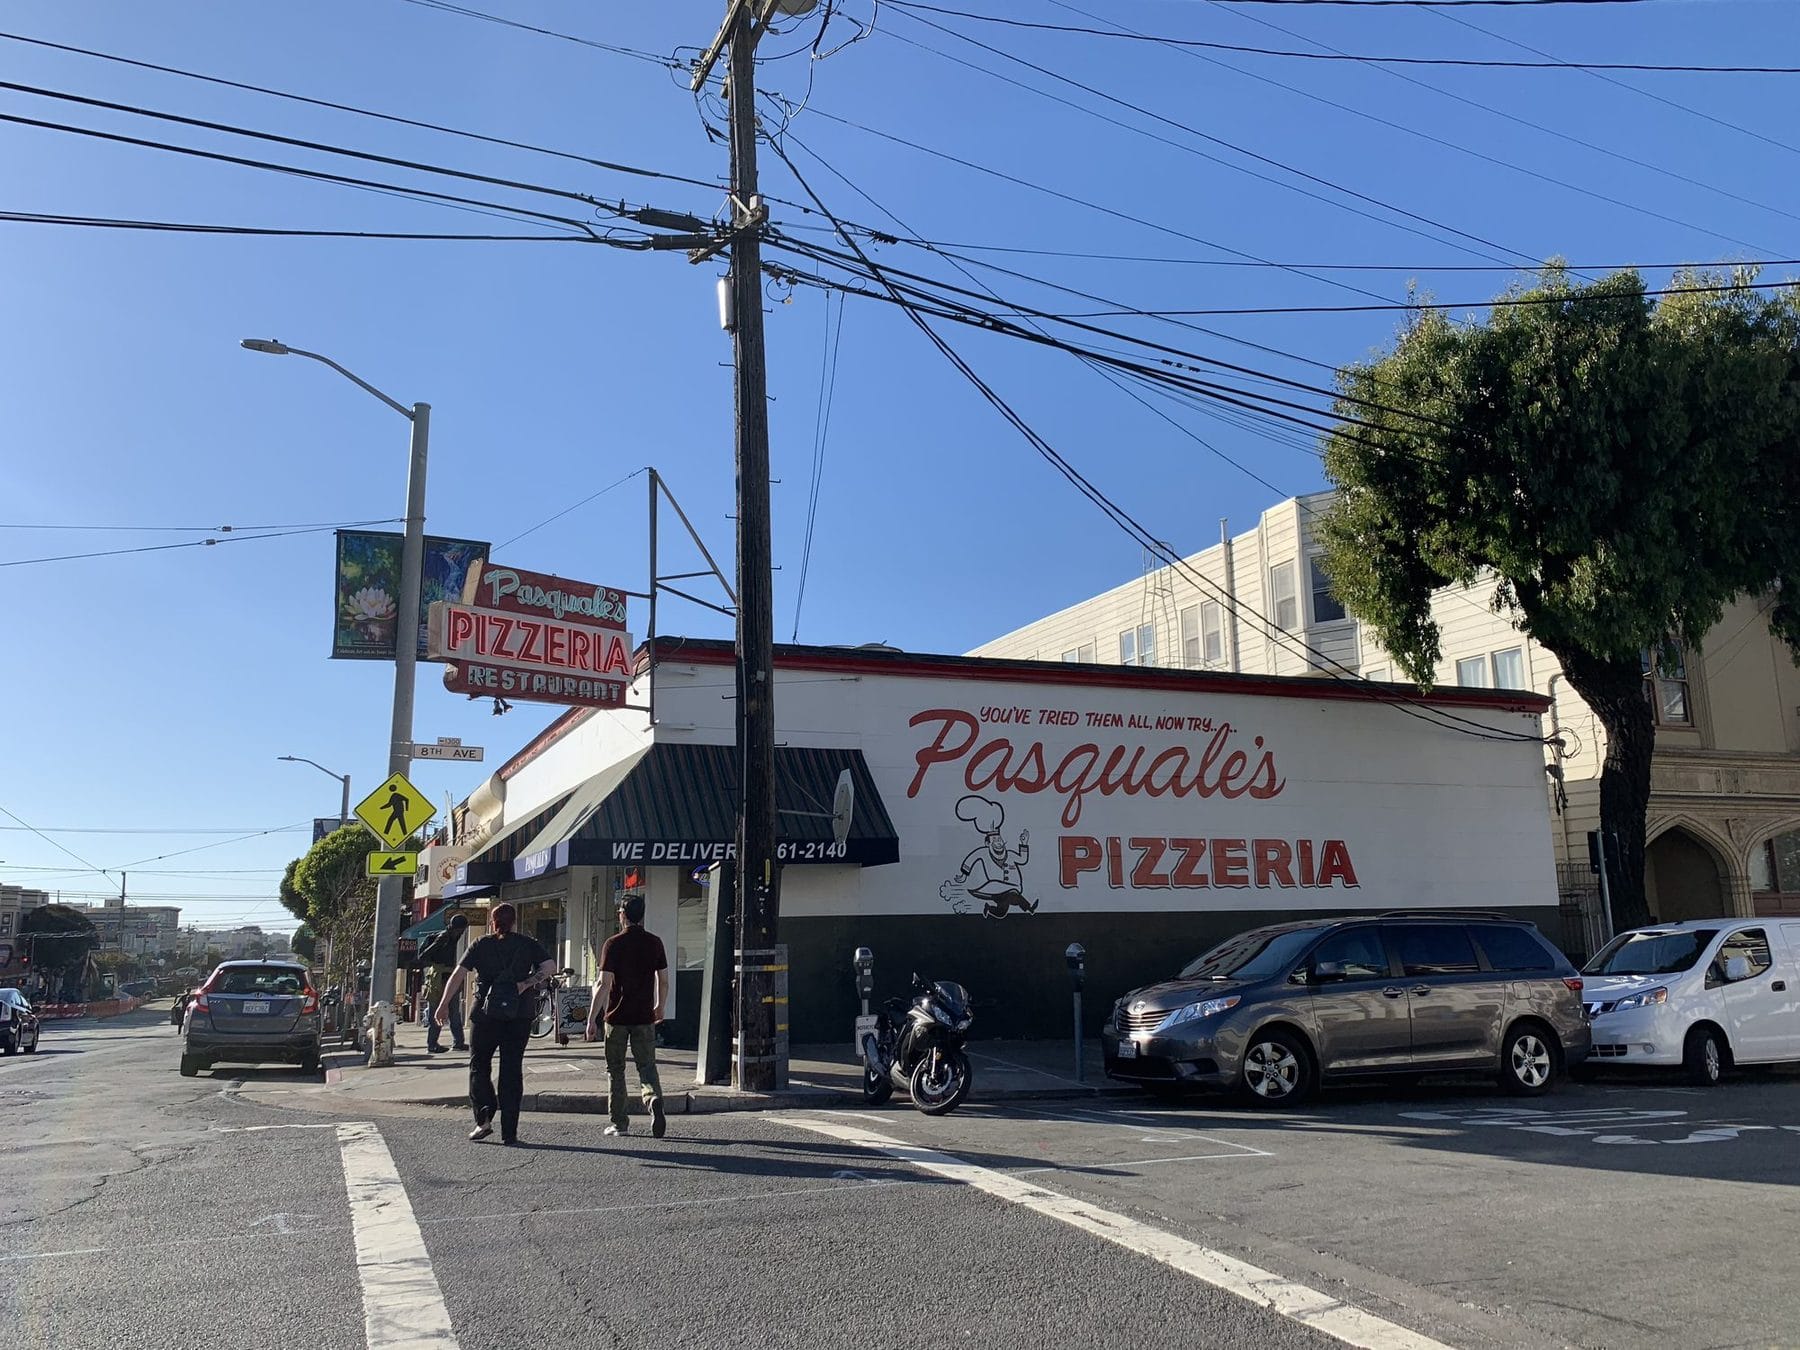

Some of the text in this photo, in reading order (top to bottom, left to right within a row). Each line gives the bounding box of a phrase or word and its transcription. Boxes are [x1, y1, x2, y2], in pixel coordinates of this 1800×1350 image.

[483, 568, 626, 623] Pasquale's
[447, 607, 631, 676] PIZZERIA
[467, 664, 622, 702] RESTAURANT
[980, 706, 1032, 725] YOU'VE
[1039, 709, 1080, 726] TRIED
[1085, 712, 1123, 728] THEM
[1127, 714, 1153, 731] ALL,
[1155, 716, 1185, 731] NOW
[420, 747, 477, 759] 8TH AVE
[907, 708, 1286, 828] Pasquale's
[612, 842, 645, 860] WE
[1058, 835, 1361, 890] PIZZERIA
